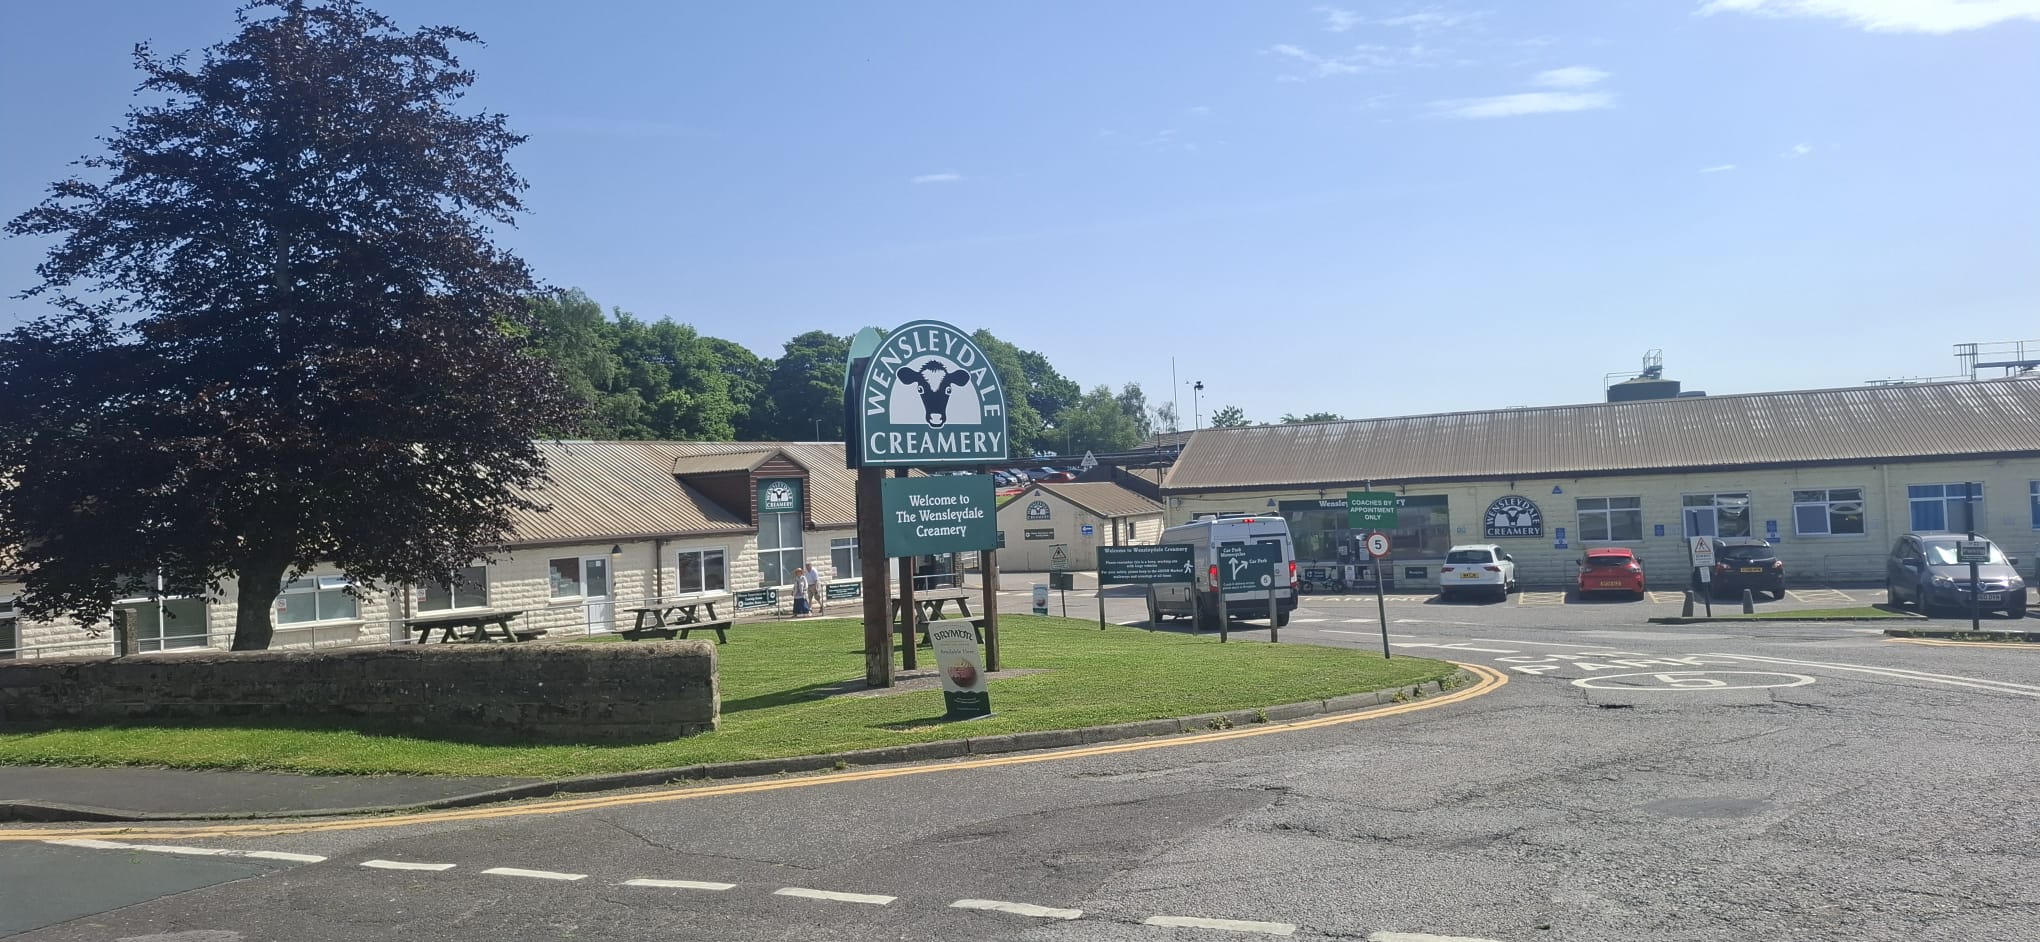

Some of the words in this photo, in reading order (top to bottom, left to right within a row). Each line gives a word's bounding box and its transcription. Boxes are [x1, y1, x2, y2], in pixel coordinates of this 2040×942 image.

[867, 330, 1001, 417] WENSLEYDALE
[870, 432, 1001, 455] CREAMERY
[909, 494, 957, 507] Welcome
[959, 494, 970, 505] to
[1319, 500, 1348, 508] Wensley
[896, 511, 916, 523] The
[918, 508, 984, 522] Wensleydale
[1486, 498, 1540, 525] WENSLEYDALE
[916, 525, 967, 537] Creamery
[1487, 527, 1540, 535] CREAMERY
[1374, 539, 1382, 550] 5
[933, 629, 973, 641] BRYMOR
[1654, 672, 1728, 688] 5
